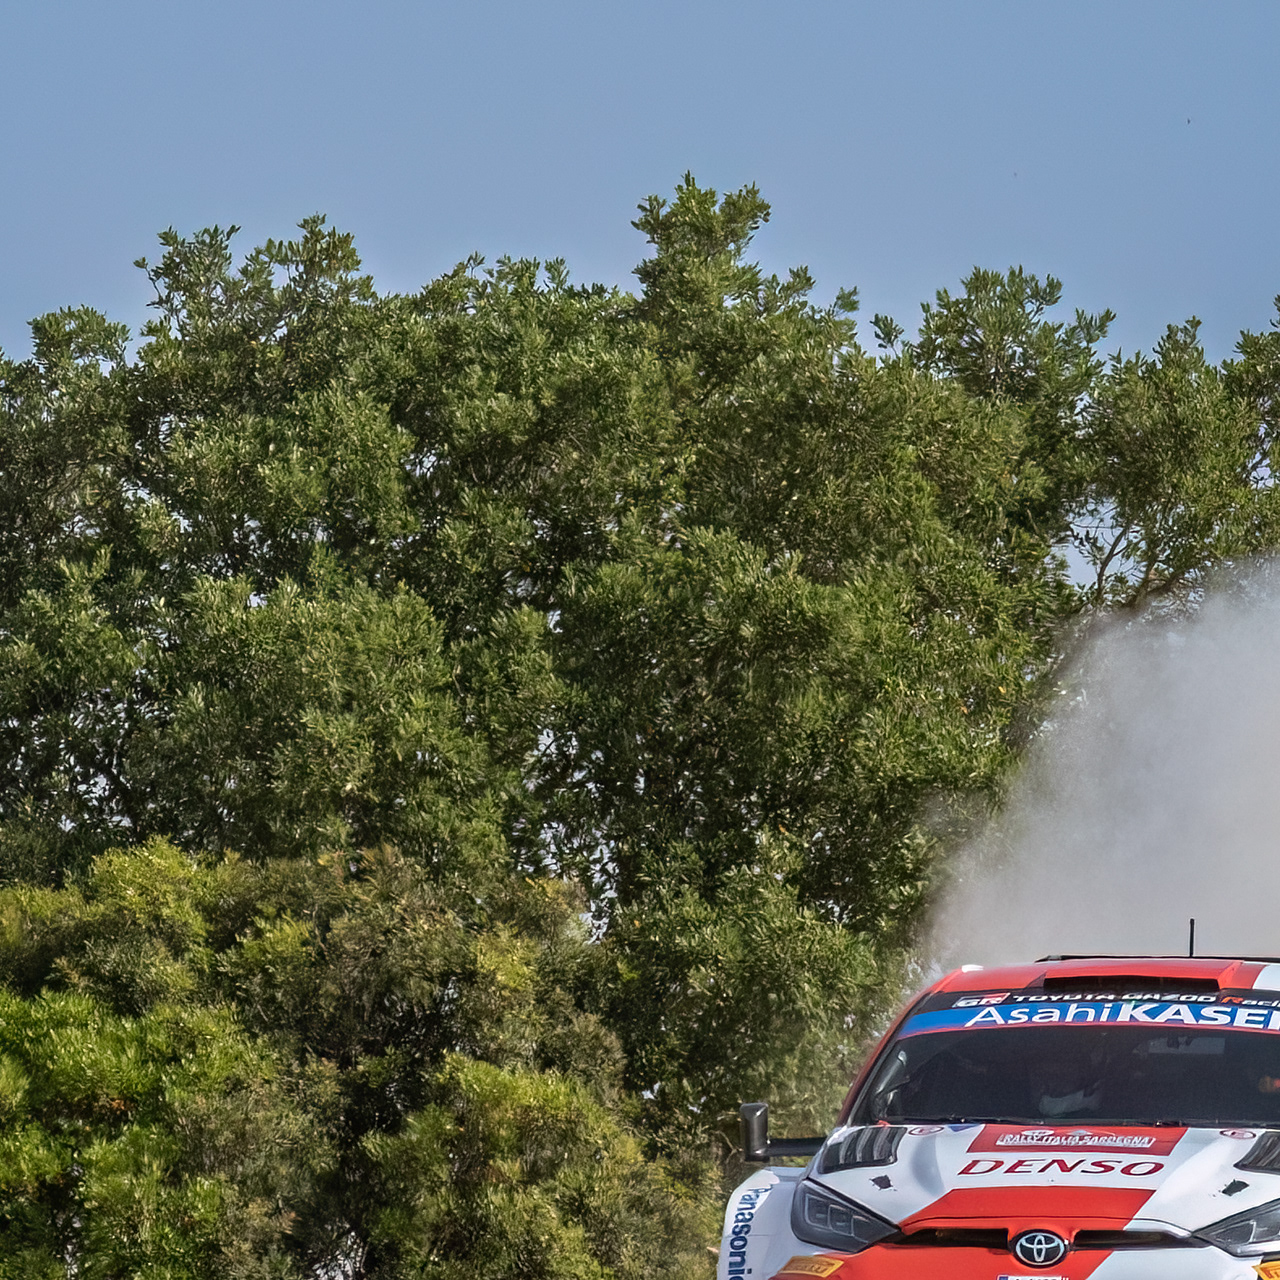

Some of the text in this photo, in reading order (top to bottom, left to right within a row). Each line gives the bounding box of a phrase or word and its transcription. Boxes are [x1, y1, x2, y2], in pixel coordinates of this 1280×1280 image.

[1013, 992, 1116, 1002] TOYOTA
[1001, 1133, 1042, 1145] RALLY
[957, 1158, 1165, 1176] DENSO
